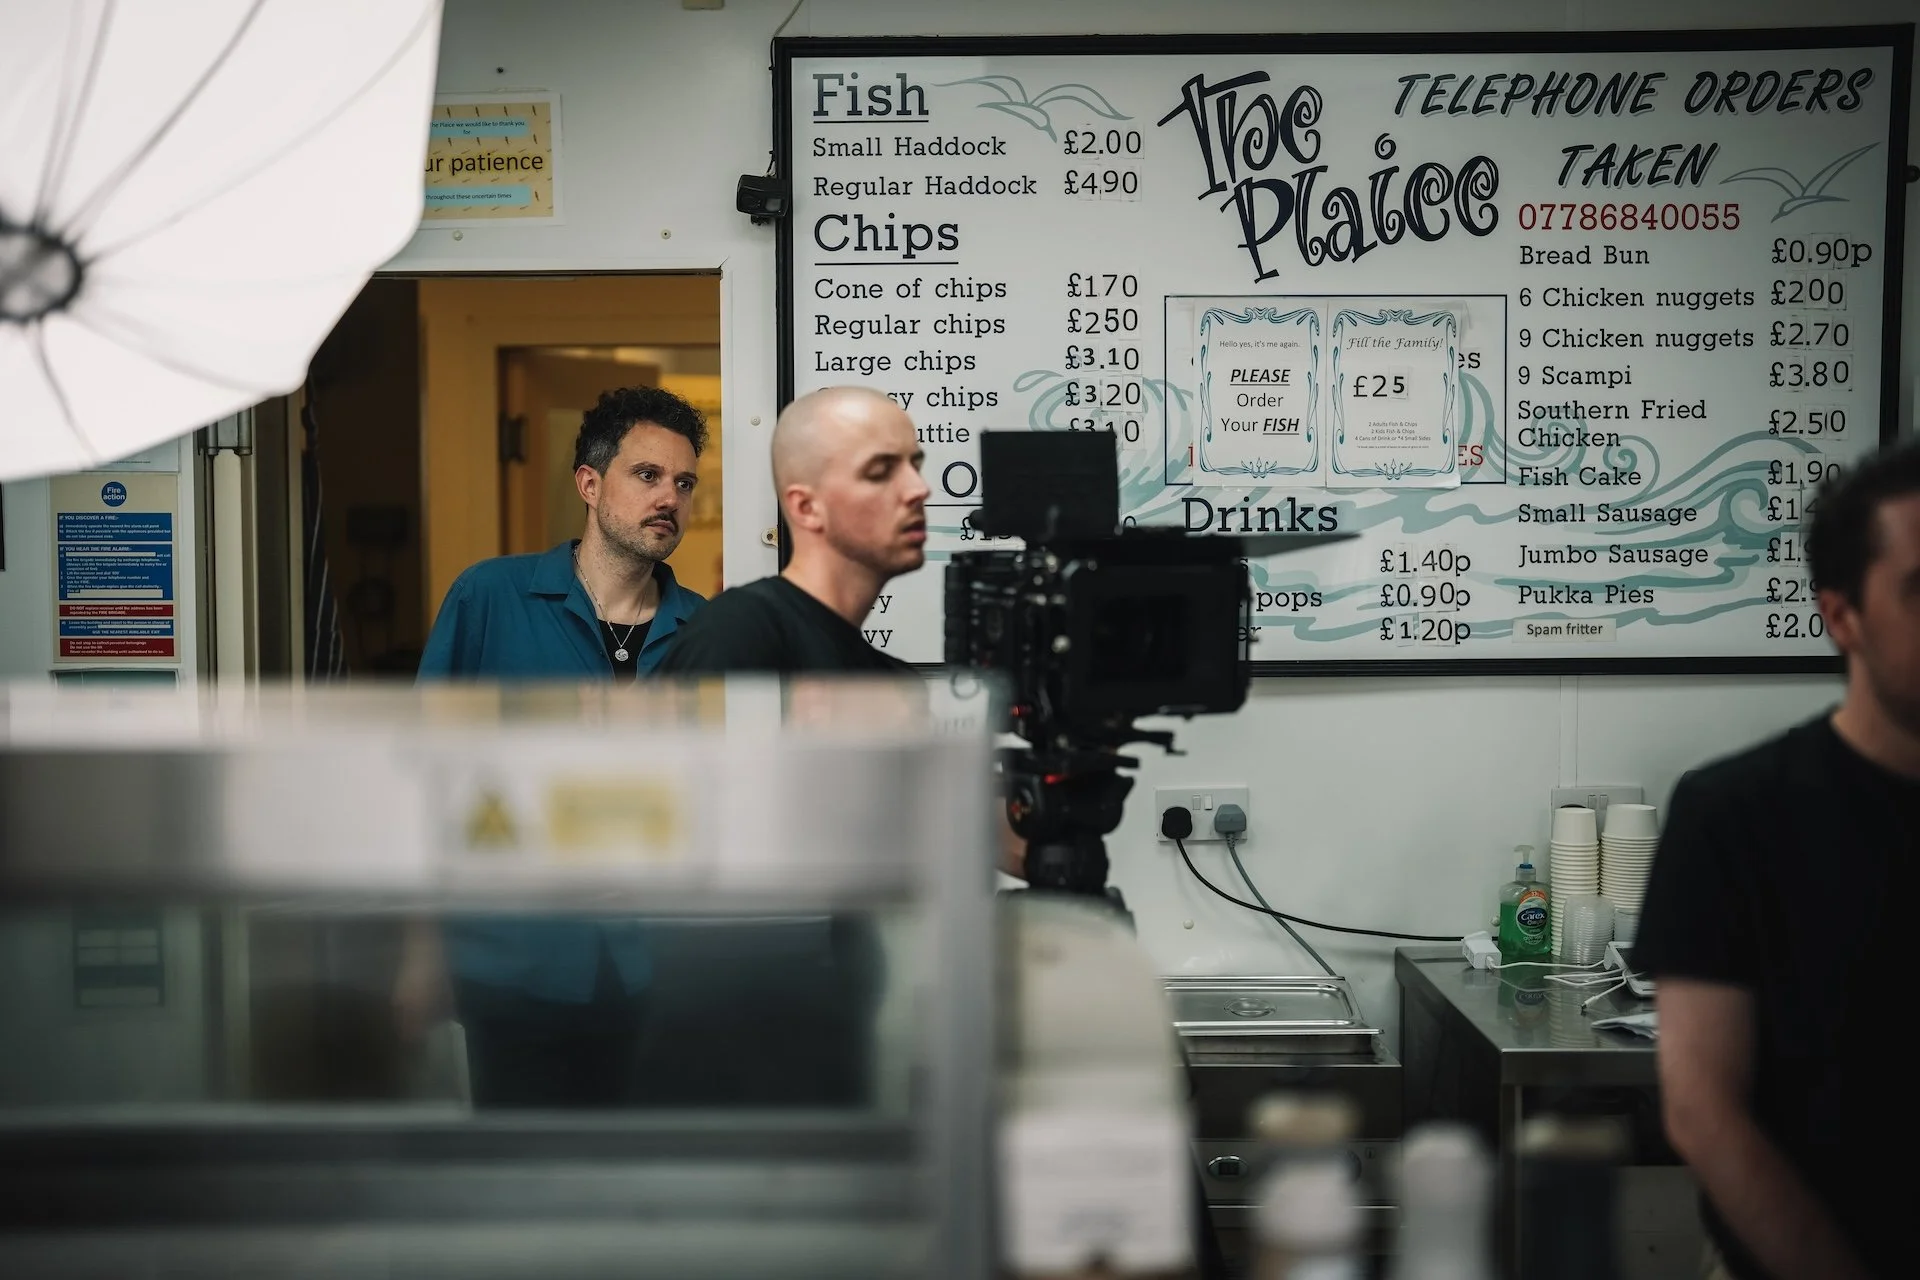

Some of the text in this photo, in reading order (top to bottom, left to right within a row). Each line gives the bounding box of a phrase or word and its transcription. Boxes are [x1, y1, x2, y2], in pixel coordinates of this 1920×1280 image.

[813, 73, 929, 116] Fish
[1395, 68, 1875, 117] TELEPHONE ORDERS
[814, 136, 1006, 156] Small Haddock
[1064, 130, 1141, 154] £2.00
[1157, 71, 1322, 201] The
[451, 153, 543, 176] patience
[1558, 143, 1720, 187] TAKEN
[814, 176, 1036, 200] Regular Haddock
[1220, 133, 1499, 283] Plaice
[1518, 203, 1740, 230] 07786840055
[814, 213, 958, 259] Chips
[1520, 245, 1649, 264] Bread Bun
[1772, 238, 1872, 268] £0.90p
[815, 277, 1006, 302] Cone of chips
[1520, 287, 1754, 310] 6 Chicken nuggets
[1771, 278, 1844, 305] £200
[815, 313, 1004, 339] Regular chips
[1068, 308, 1138, 334] £250
[1346, 336, 1444, 352] Fill the Family!
[1520, 328, 1753, 351] 9 Chicken nuggets
[1770, 321, 1850, 347] £2.70
[815, 350, 975, 375] Large chips
[1066, 345, 1139, 370] £3.10
[1230, 369, 1290, 383] PLEASE
[1519, 365, 1631, 388] 9 Scampi
[1770, 360, 1848, 387] £3.80
[927, 386, 997, 410] chips
[1353, 375, 1405, 398] £25
[1237, 393, 1283, 406] Order
[1519, 400, 1706, 419] Southern Fried
[1221, 418, 1300, 432] Your FISH
[1519, 428, 1620, 447] Chicken
[1519, 467, 1641, 485] Fish Cake
[1182, 497, 1338, 532] Drinks
[1519, 504, 1696, 526] Small Sausage
[1380, 549, 1471, 577] £1.40p
[1519, 545, 1708, 567] Jumbo Sausage
[1256, 592, 1322, 612] pops
[1380, 582, 1470, 610] £0.90p
[1519, 585, 1653, 604] Pukka Pies
[1380, 618, 1471, 644] £1.20p
[1527, 623, 1603, 637] Spam fritter
[1766, 614, 1824, 638] £2.0
